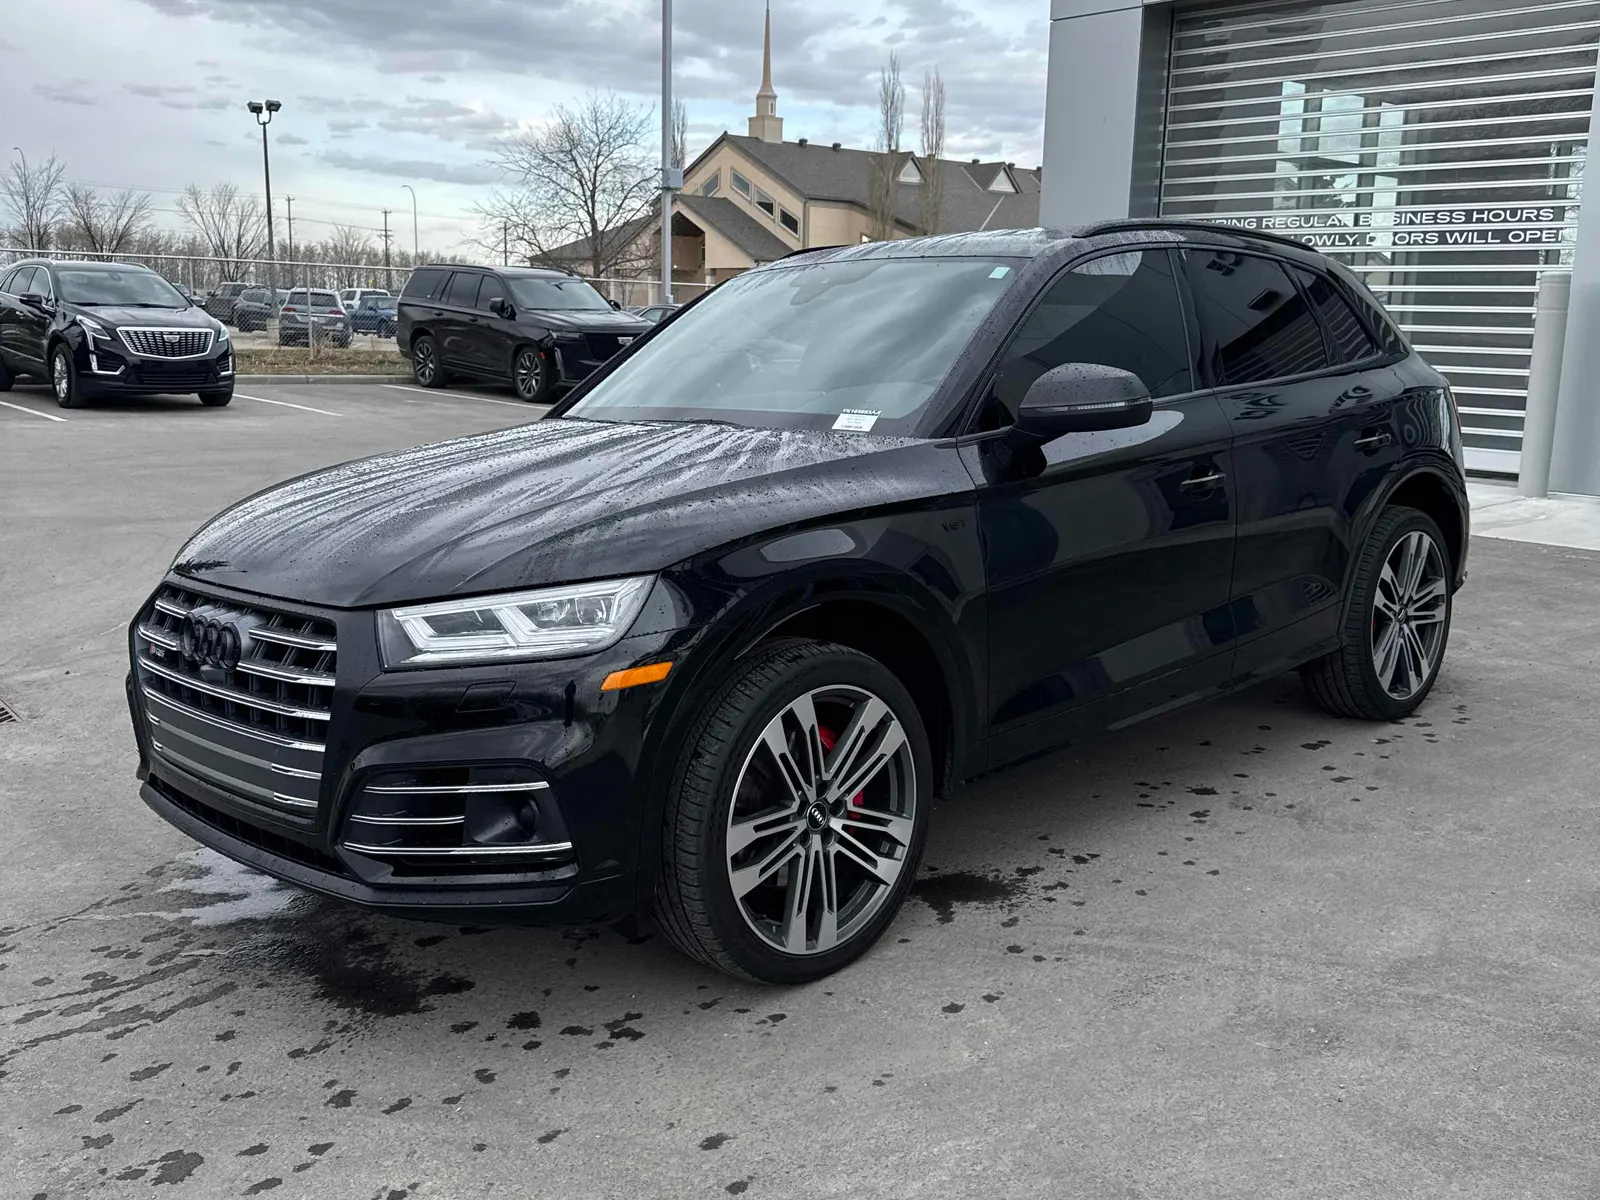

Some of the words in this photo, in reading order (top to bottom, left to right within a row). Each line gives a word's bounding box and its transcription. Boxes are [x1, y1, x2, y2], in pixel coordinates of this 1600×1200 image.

[1472, 208, 1554, 222] HOURS
[1290, 233, 1360, 246] OWLY.
[1446, 231, 1501, 243] WILL
